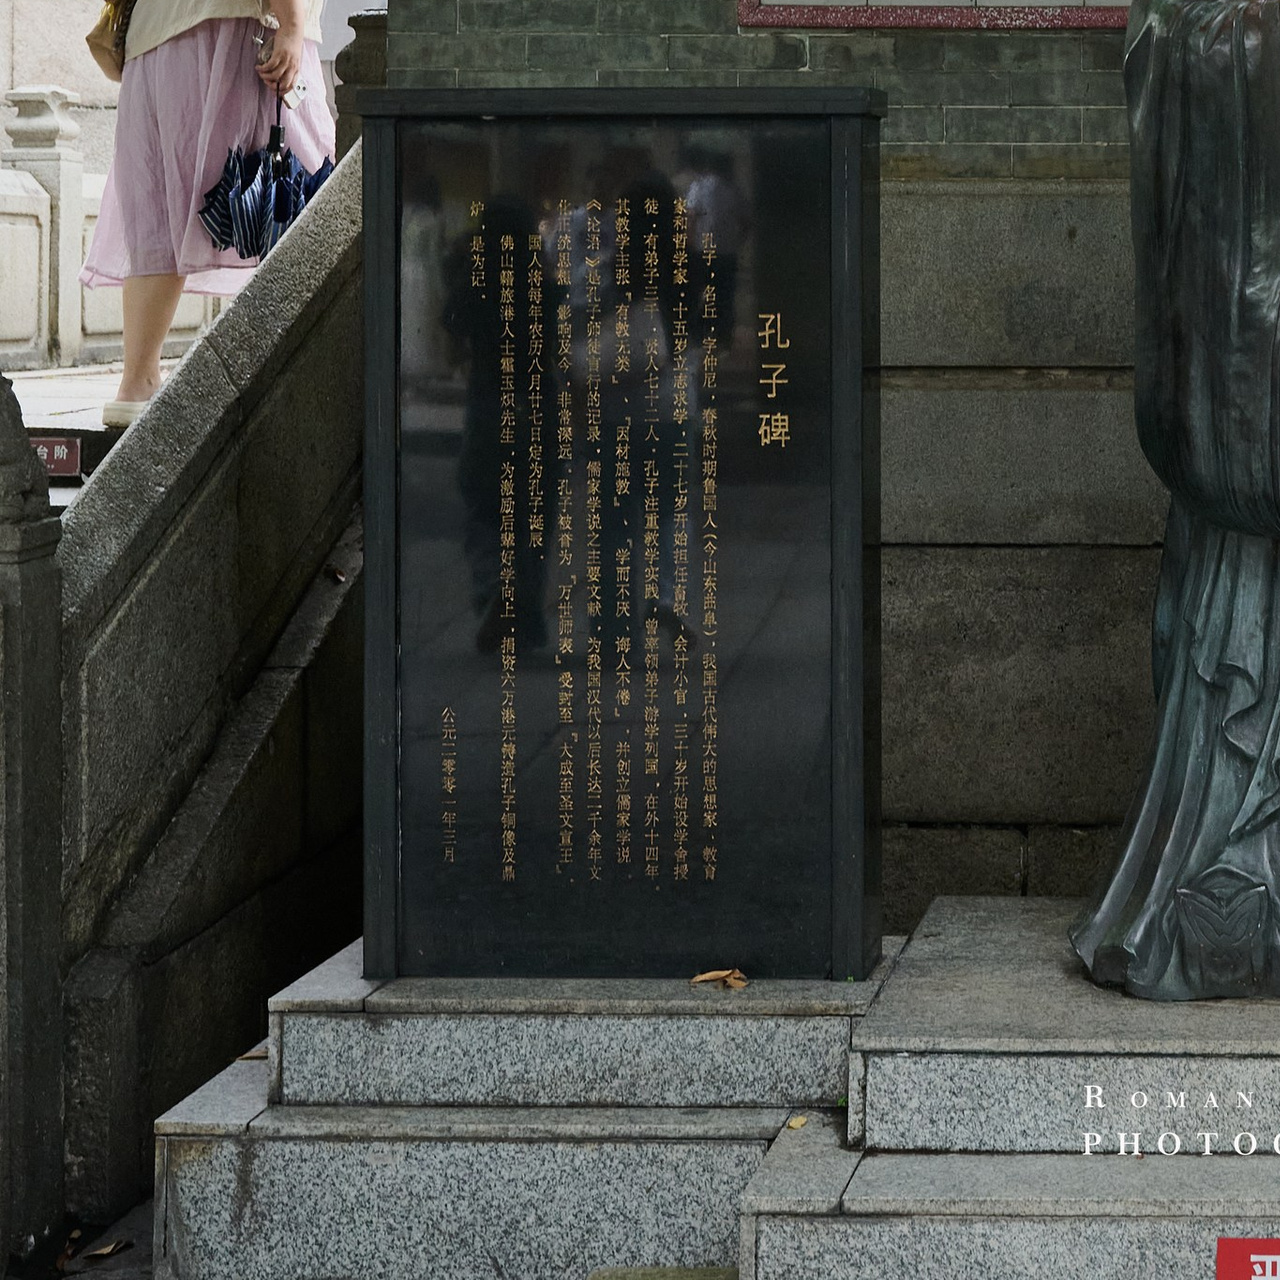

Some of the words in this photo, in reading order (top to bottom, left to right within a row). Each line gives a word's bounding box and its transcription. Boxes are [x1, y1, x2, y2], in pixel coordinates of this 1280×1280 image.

[757, 311, 791, 449] 孔子碑
[441, 706, 457, 864] 公元二零零一年三月
